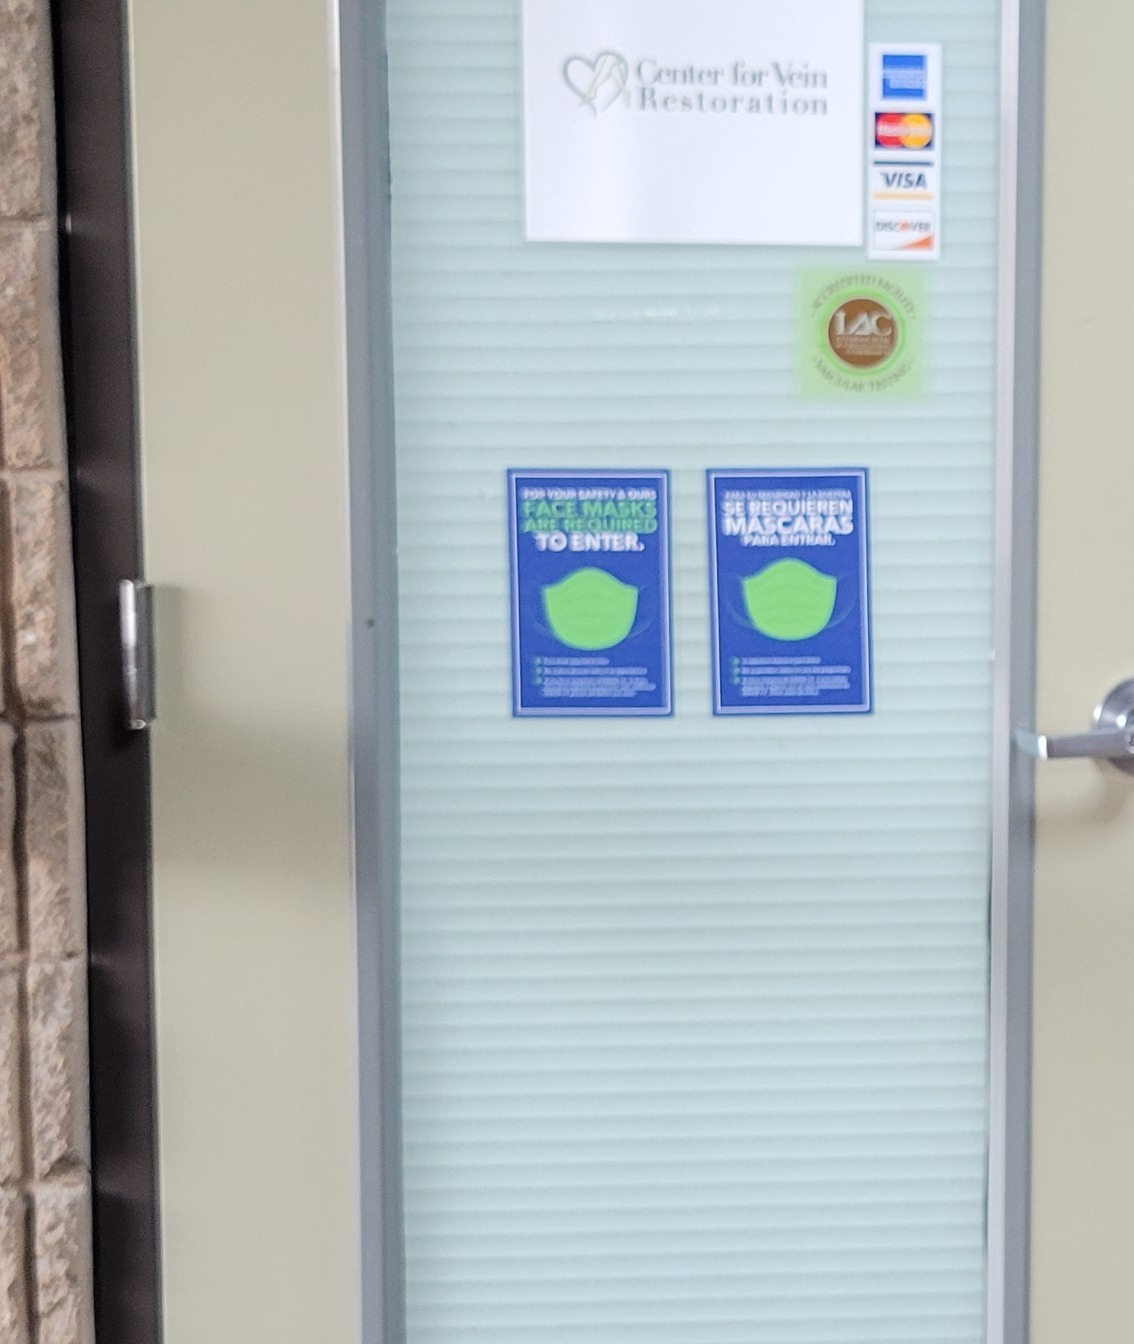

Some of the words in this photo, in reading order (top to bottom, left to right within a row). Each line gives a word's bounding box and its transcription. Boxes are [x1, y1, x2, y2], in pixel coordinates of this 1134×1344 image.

[636, 58, 725, 86] Center
[732, 59, 770, 87] for
[771, 59, 828, 89] Vein
[638, 85, 829, 116] Restoration
[881, 172, 928, 189] VISA
[524, 500, 577, 517] FACE
[581, 500, 657, 518] MASKS
[722, 499, 746, 517] SE
[747, 499, 854, 517] REQUIEREN
[523, 517, 558, 532] ARE
[562, 516, 658, 534] REQUIRED
[722, 515, 855, 536] MASCARAS
[534, 530, 568, 552] TO
[570, 531, 646, 552] ENTER.
